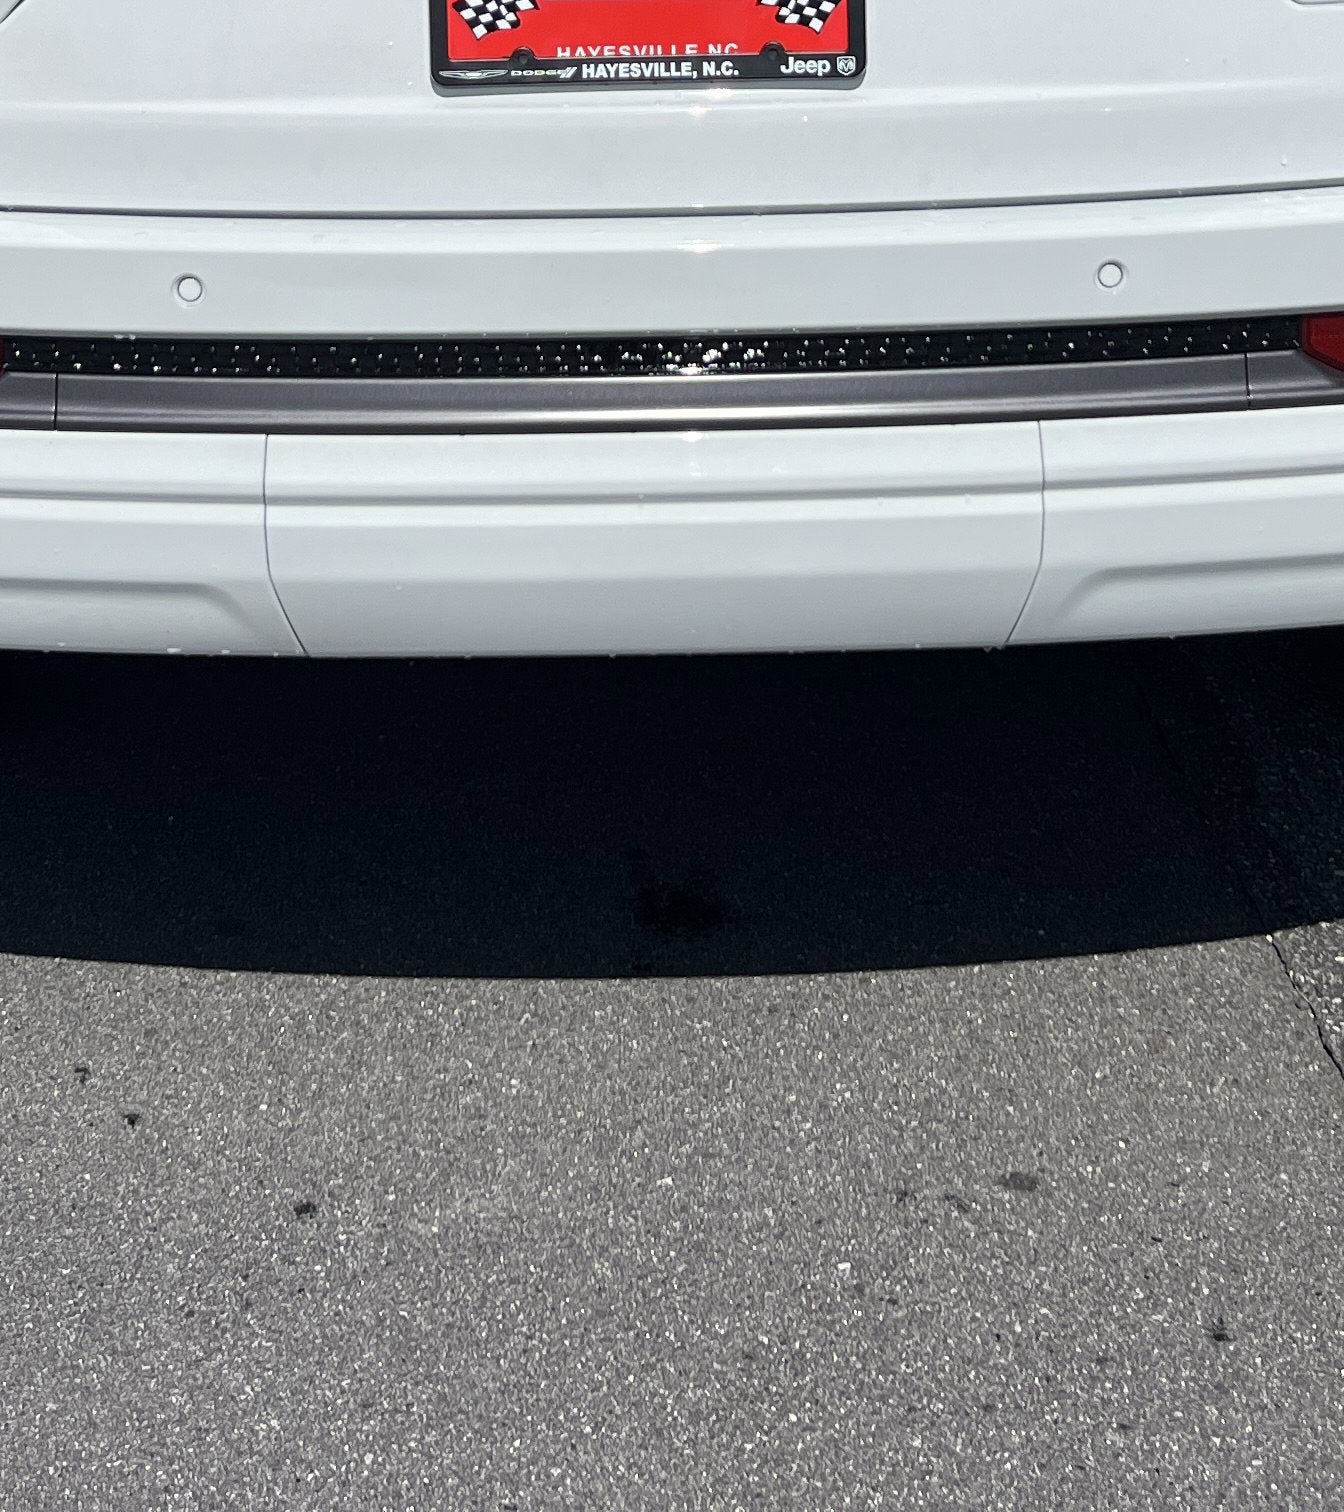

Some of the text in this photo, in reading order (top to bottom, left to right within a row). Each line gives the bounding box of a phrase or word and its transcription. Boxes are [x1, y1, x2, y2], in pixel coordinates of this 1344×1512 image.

[582, 61, 698, 79] HAYESVILLE,
[702, 61, 739, 77] N.C.
[780, 56, 831, 77] Jeep
